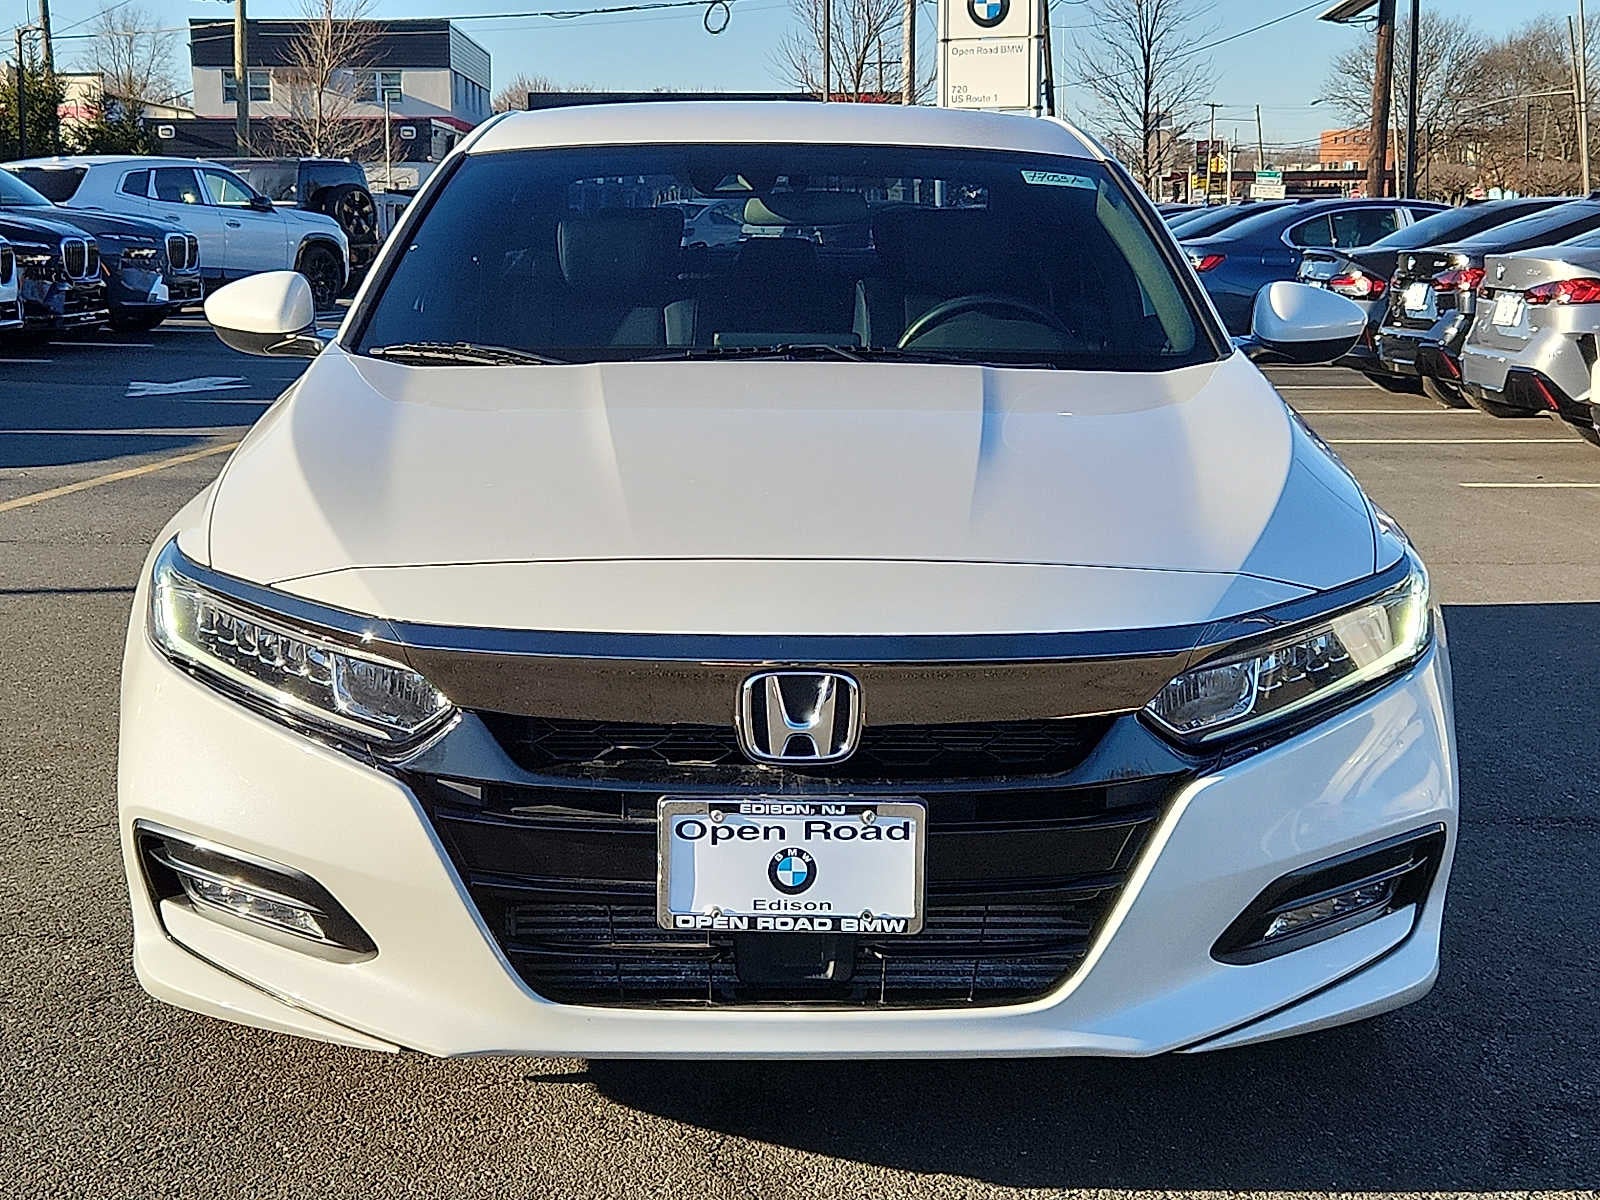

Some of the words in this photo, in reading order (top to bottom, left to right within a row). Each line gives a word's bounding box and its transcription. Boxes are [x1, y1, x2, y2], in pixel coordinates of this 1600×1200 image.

[951, 47, 975, 57] Open
[976, 46, 999, 55] Road
[1000, 45, 1024, 54] BMW
[951, 85, 968, 94] 720
[951, 95, 964, 103] US
[965, 95, 991, 103] Route
[993, 94, 998, 102] 1
[739, 803, 816, 816] EDISON,
[821, 804, 846, 815] NJ
[675, 819, 786, 846] Open
[804, 820, 910, 841] Road
[774, 848, 813, 863] BMW
[752, 899, 832, 911] Edison
[675, 915, 749, 930] OPEN
[756, 916, 833, 931] ROAD
[840, 917, 906, 933] BMW
